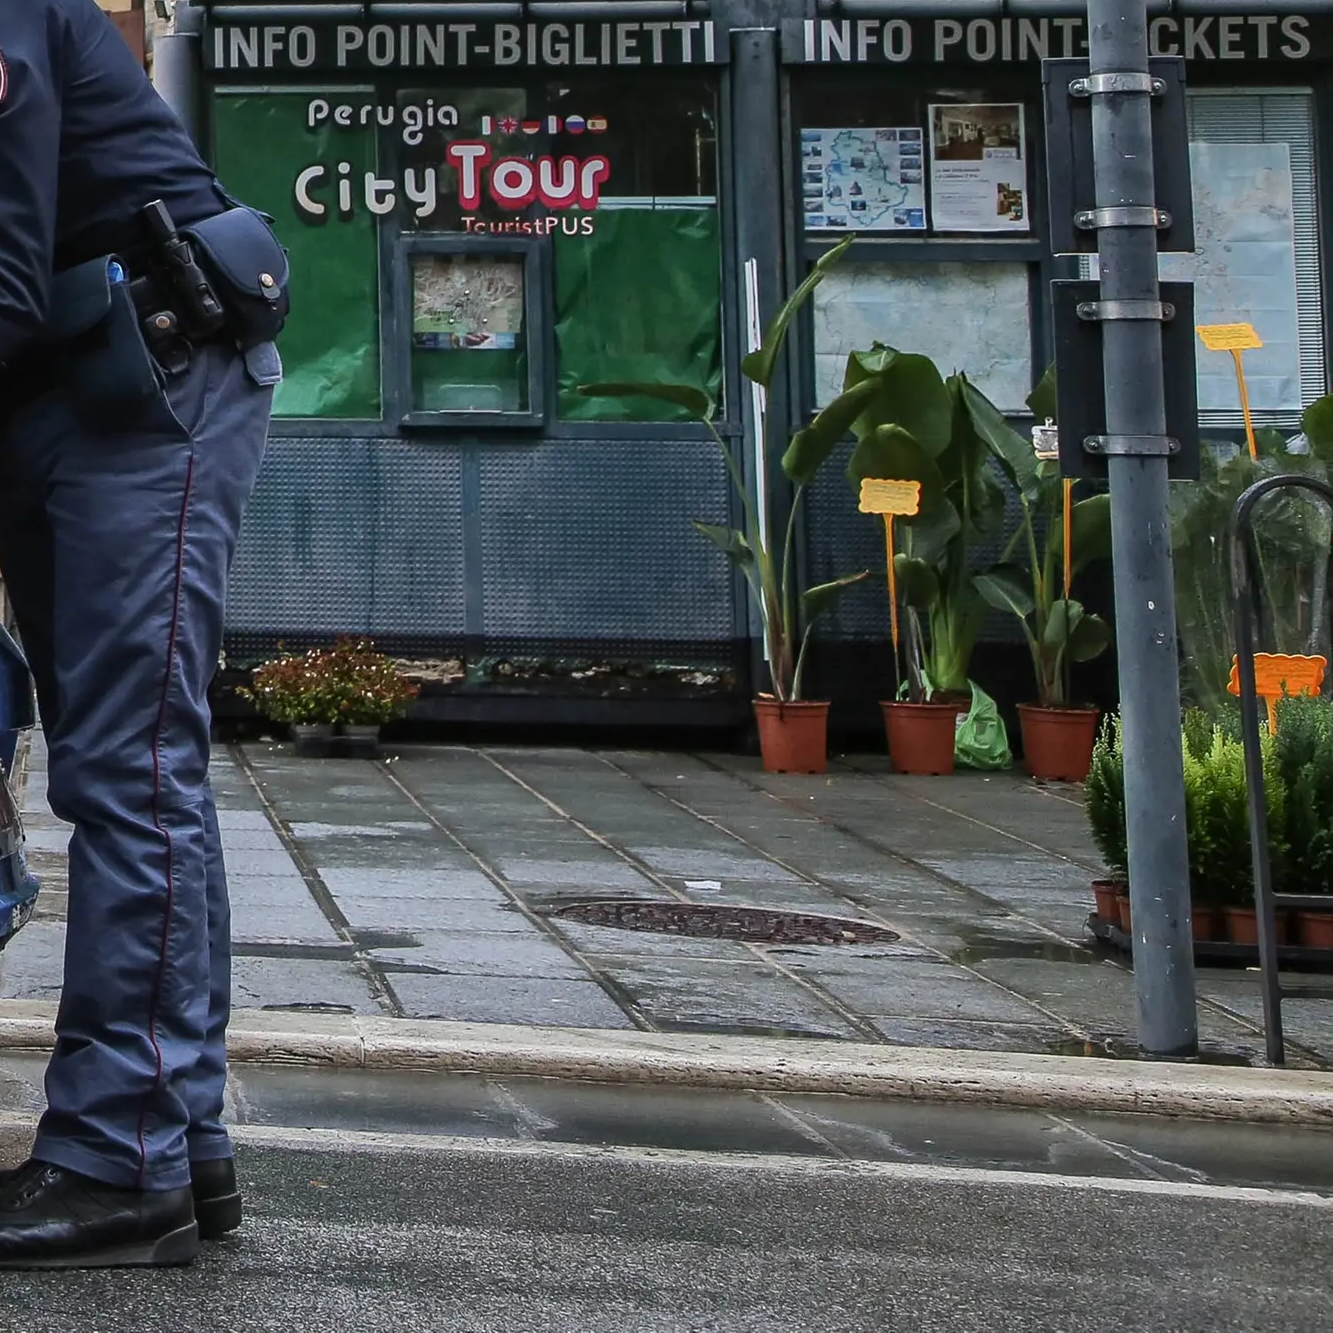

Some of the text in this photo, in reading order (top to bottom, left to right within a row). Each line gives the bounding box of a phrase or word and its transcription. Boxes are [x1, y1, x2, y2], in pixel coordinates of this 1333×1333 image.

[214, 20, 714, 68] INFO POINT-BIGLIETTI
[803, 18, 913, 62] INFO
[308, 99, 459, 145] Perugia
[295, 140, 610, 217] City Tour
